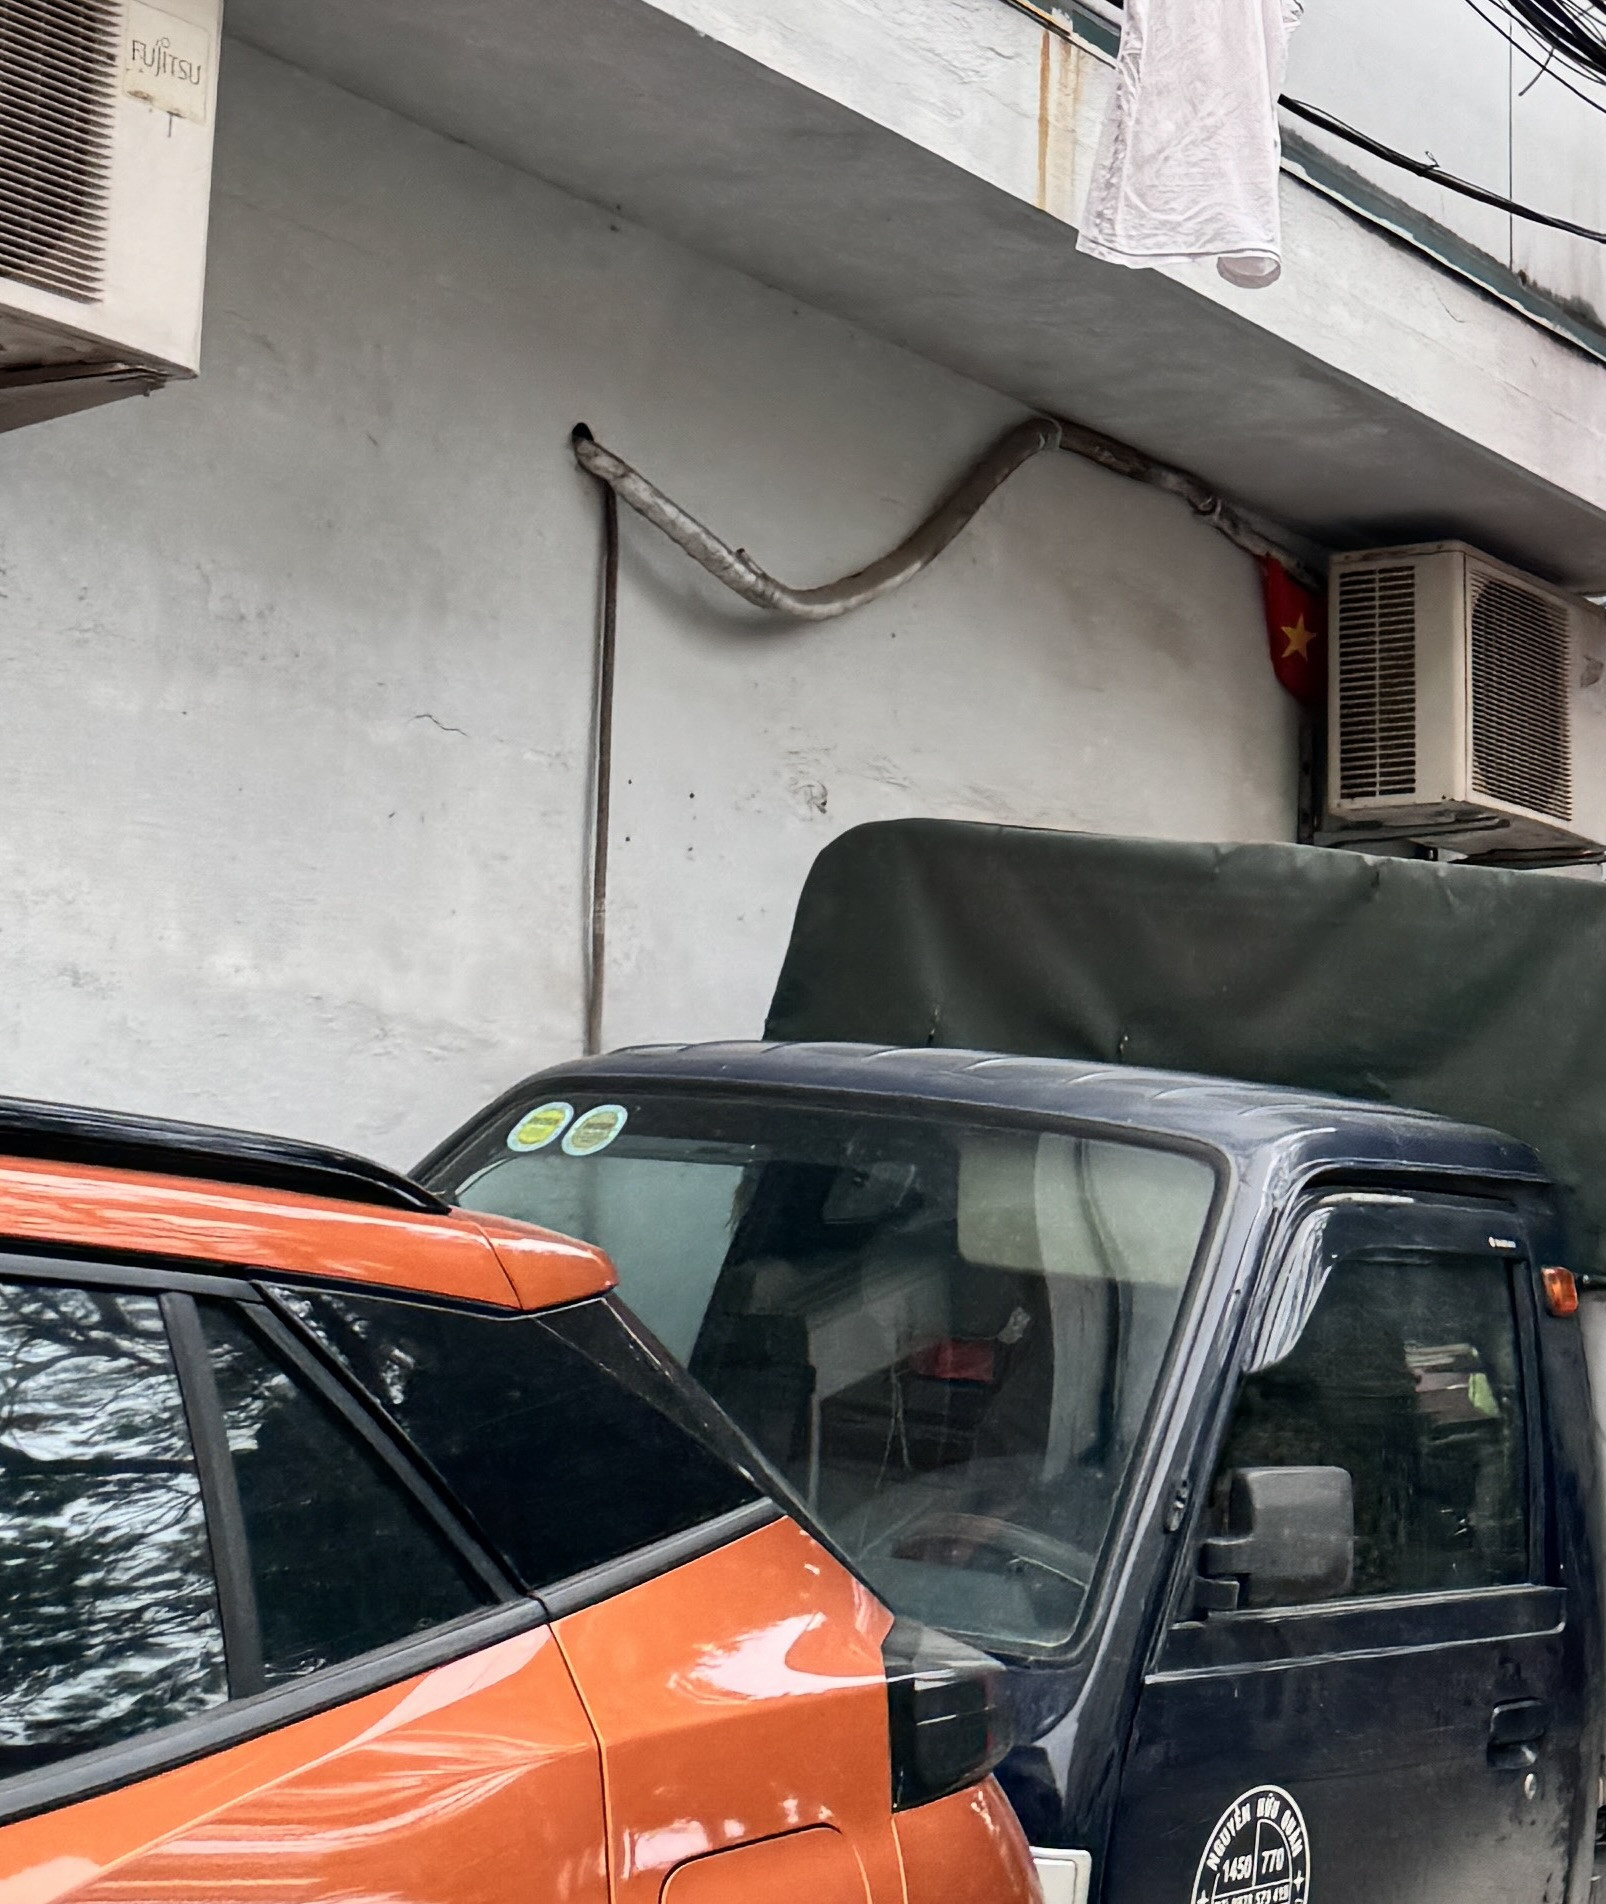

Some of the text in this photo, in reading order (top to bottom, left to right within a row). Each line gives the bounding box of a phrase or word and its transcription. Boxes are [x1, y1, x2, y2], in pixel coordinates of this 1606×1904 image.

[131, 37, 202, 85] FUJITSU
[1222, 1853, 1253, 1884] 1450
[1261, 1847, 1285, 1875] 770
